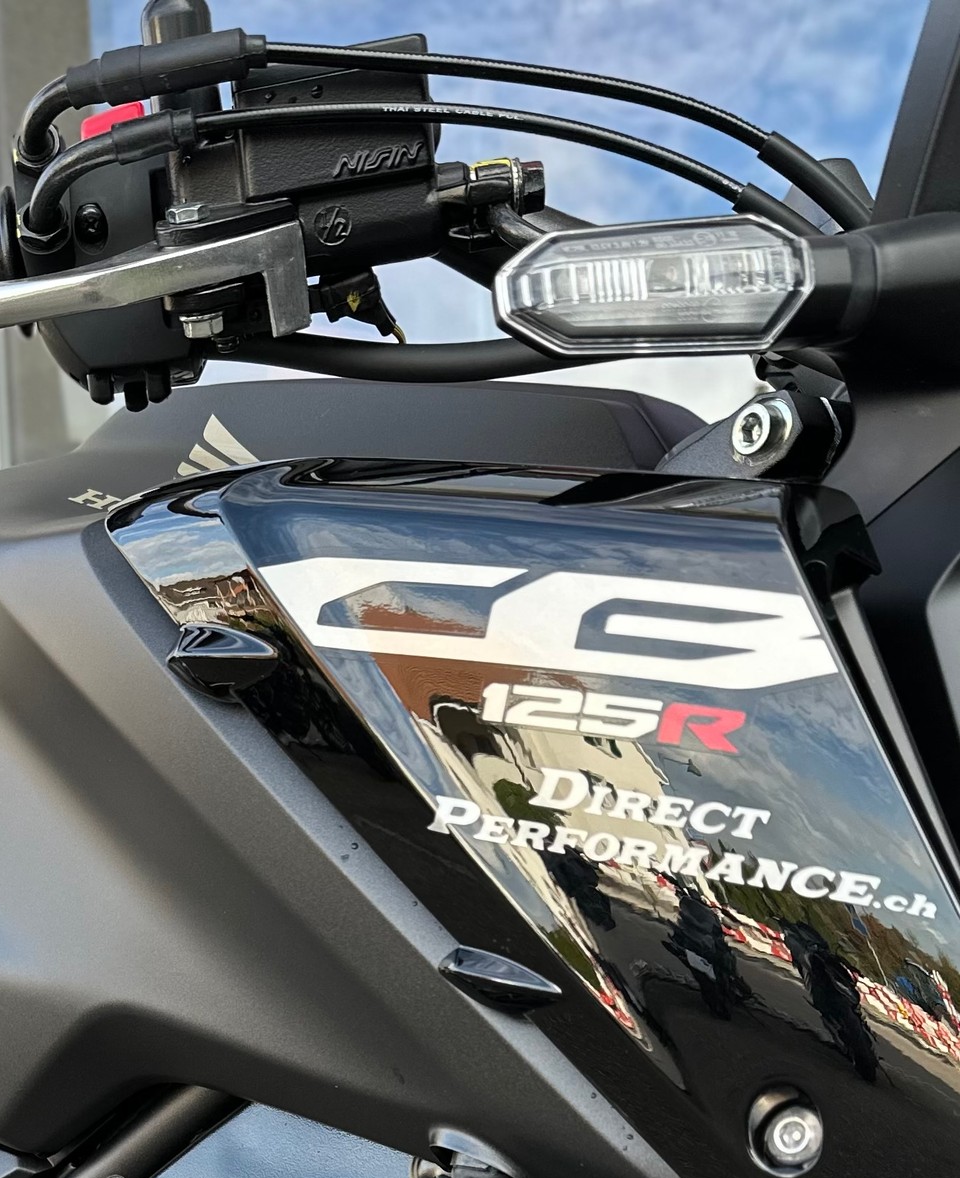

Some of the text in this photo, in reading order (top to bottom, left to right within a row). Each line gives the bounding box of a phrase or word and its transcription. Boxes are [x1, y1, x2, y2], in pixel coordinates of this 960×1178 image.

[455, 109, 493, 117] CABLE
[258, 556, 839, 690] CB
[481, 682, 746, 754] 125R
[529, 767, 771, 840] DIRECT
[427, 794, 938, 921] PERFORMANCE.ch
